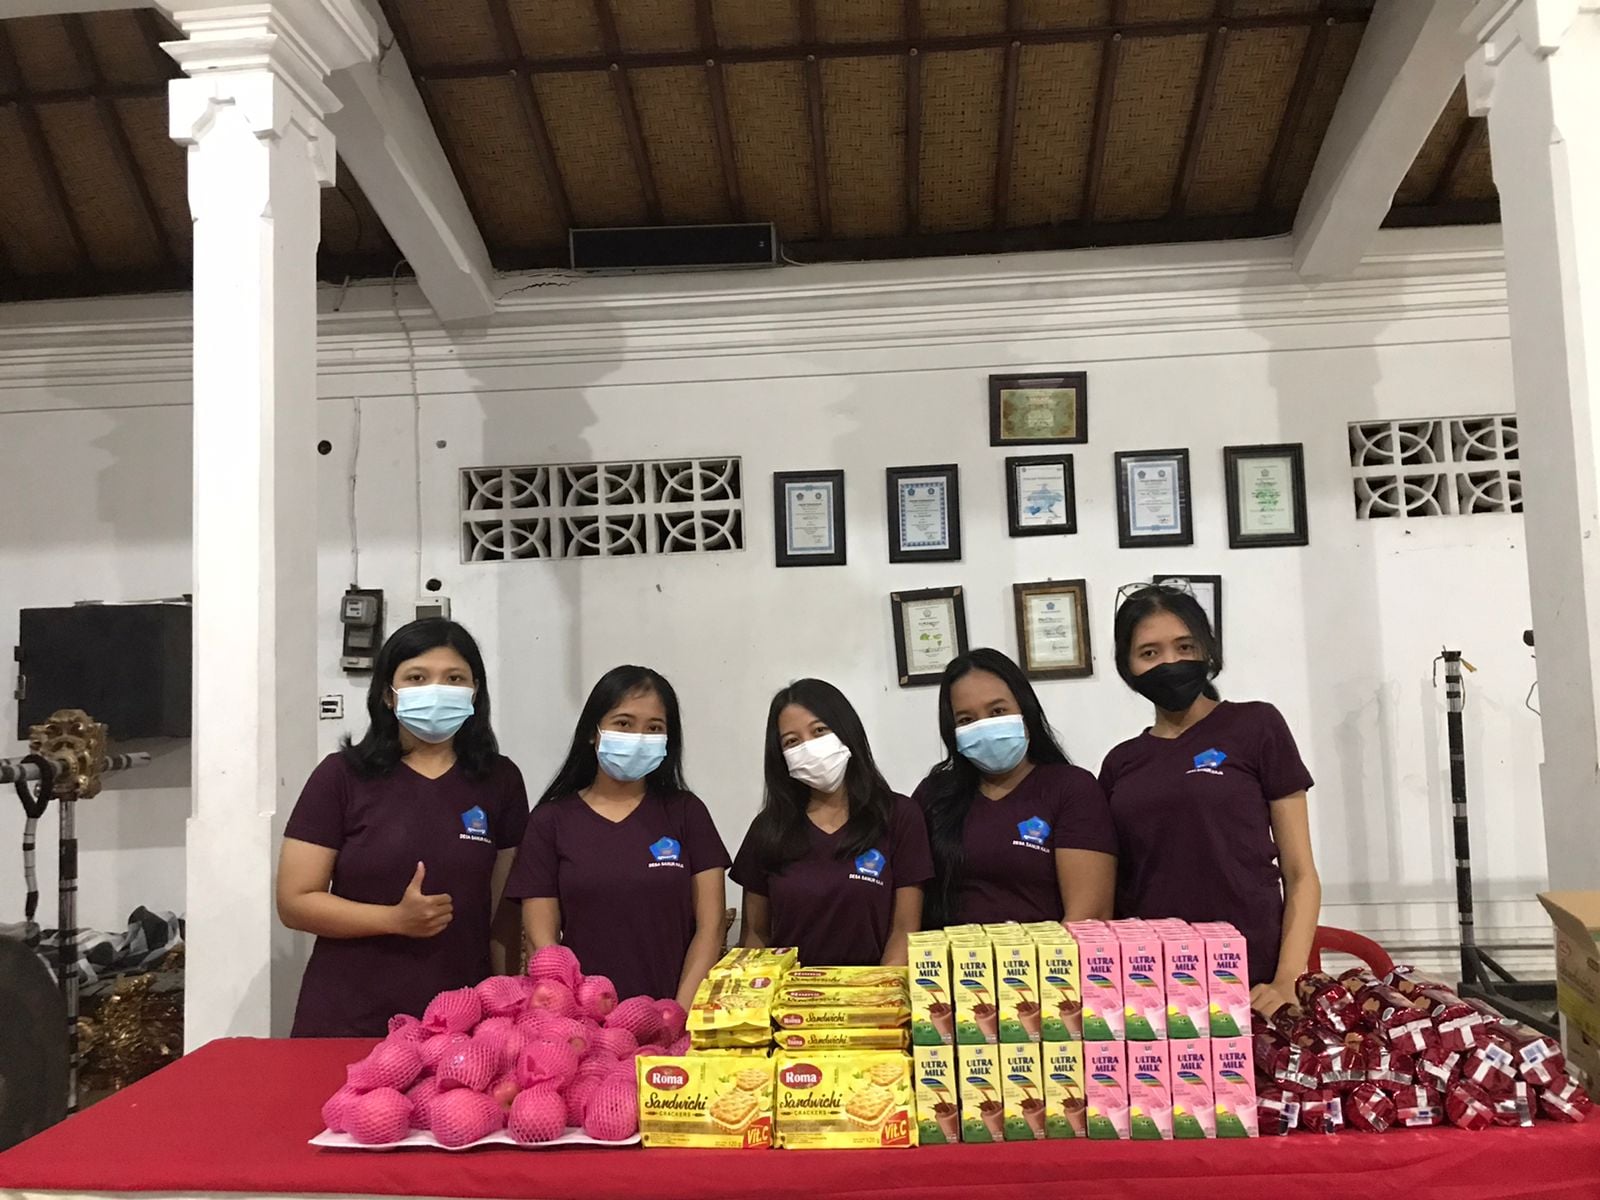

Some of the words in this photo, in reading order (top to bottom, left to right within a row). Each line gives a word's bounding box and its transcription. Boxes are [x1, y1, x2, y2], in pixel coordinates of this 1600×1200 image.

[1088, 957, 1115, 965] ULTRA
[1129, 956, 1156, 964] ULTRA
[1172, 956, 1199, 964] ULTRA
[1214, 953, 1241, 961] ULTRA
[916, 961, 942, 970] ULTRA
[1004, 961, 1030, 969] ULTRA
[1091, 965, 1112, 973] MILK
[1133, 964, 1154, 972] MILK
[1176, 963, 1197, 971] MILK
[1217, 961, 1238, 969] MILK
[920, 969, 940, 977] MILK
[964, 970, 985, 978] MILK
[1007, 968, 1028, 976] MILK
[1050, 967, 1070, 975] MILK
[1008, 1057, 1035, 1065] ULTRA
[1051, 1056, 1078, 1064] ULTRA
[1136, 1056, 1163, 1064] ULTRA
[1220, 1053, 1247, 1061] ULTRA
[922, 1061, 948, 1069] ULTRA
[967, 1060, 993, 1068] ULTRA
[1054, 1064, 1075, 1072] MILK
[1096, 1064, 1117, 1072] MILK
[1139, 1063, 1160, 1072] MILK
[1181, 1062, 1202, 1070] MILK
[1223, 1060, 1244, 1069] MILK
[925, 1069, 946, 1077] MILK
[970, 1067, 991, 1075] MILK
[1012, 1065, 1033, 1073] MILK
[652, 1072, 684, 1085] Roma
[785, 1071, 817, 1083] Roma
[645, 1091, 708, 1110] Sandwichi
[779, 1090, 843, 1108] Sandwichi
